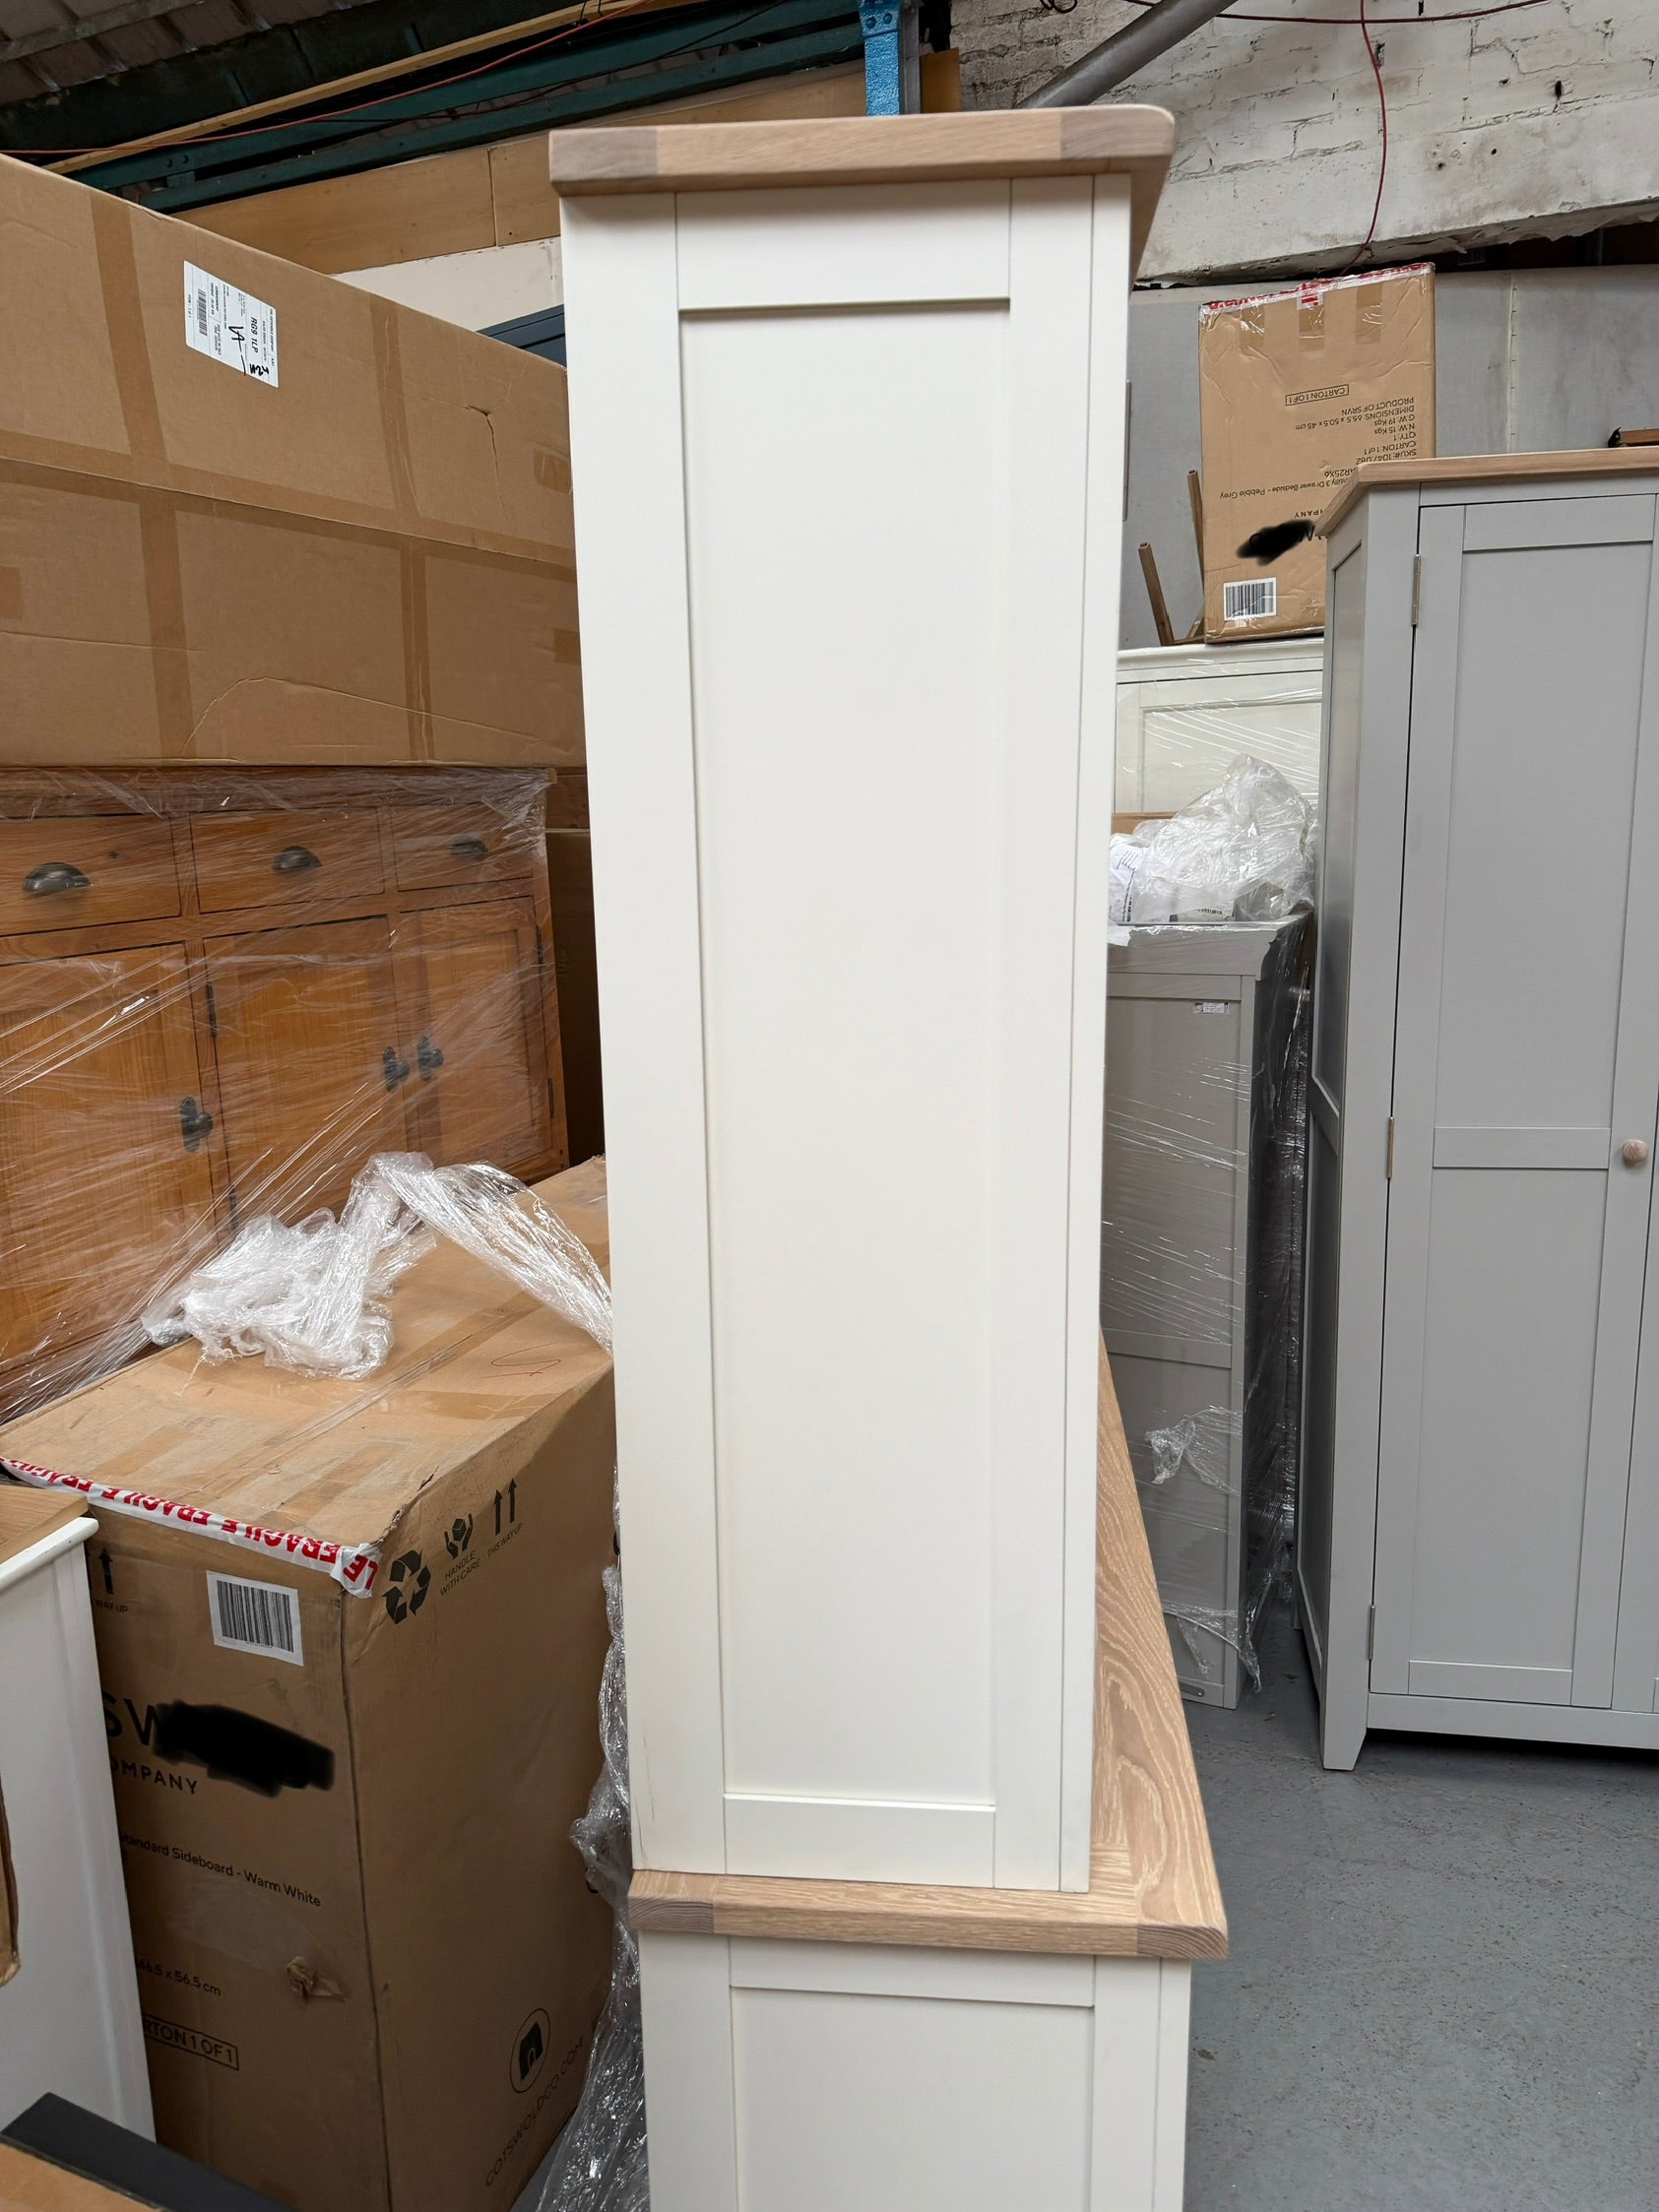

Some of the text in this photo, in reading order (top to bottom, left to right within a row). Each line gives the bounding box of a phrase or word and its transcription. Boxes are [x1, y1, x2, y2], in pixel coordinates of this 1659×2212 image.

[1311, 387, 1345, 399] CARTON
[1375, 397, 1415, 408] PRODUCT
[1341, 407, 1362, 415] SRVN
[1381, 440, 1417, 451] CARTON:
[1295, 509, 1322, 518] PANY
[445, 1550, 477, 1580] HANDLE
[440, 1558, 481, 1597] WITH CARE
[172, 1847, 234, 1876] Sideboard
[243, 1868, 282, 1893] Warm
[283, 1882, 322, 1907] White
[173, 1970, 201, 1989] 56.5
[203, 1983, 221, 1996] cm
[201, 2039, 223, 2057] OF
